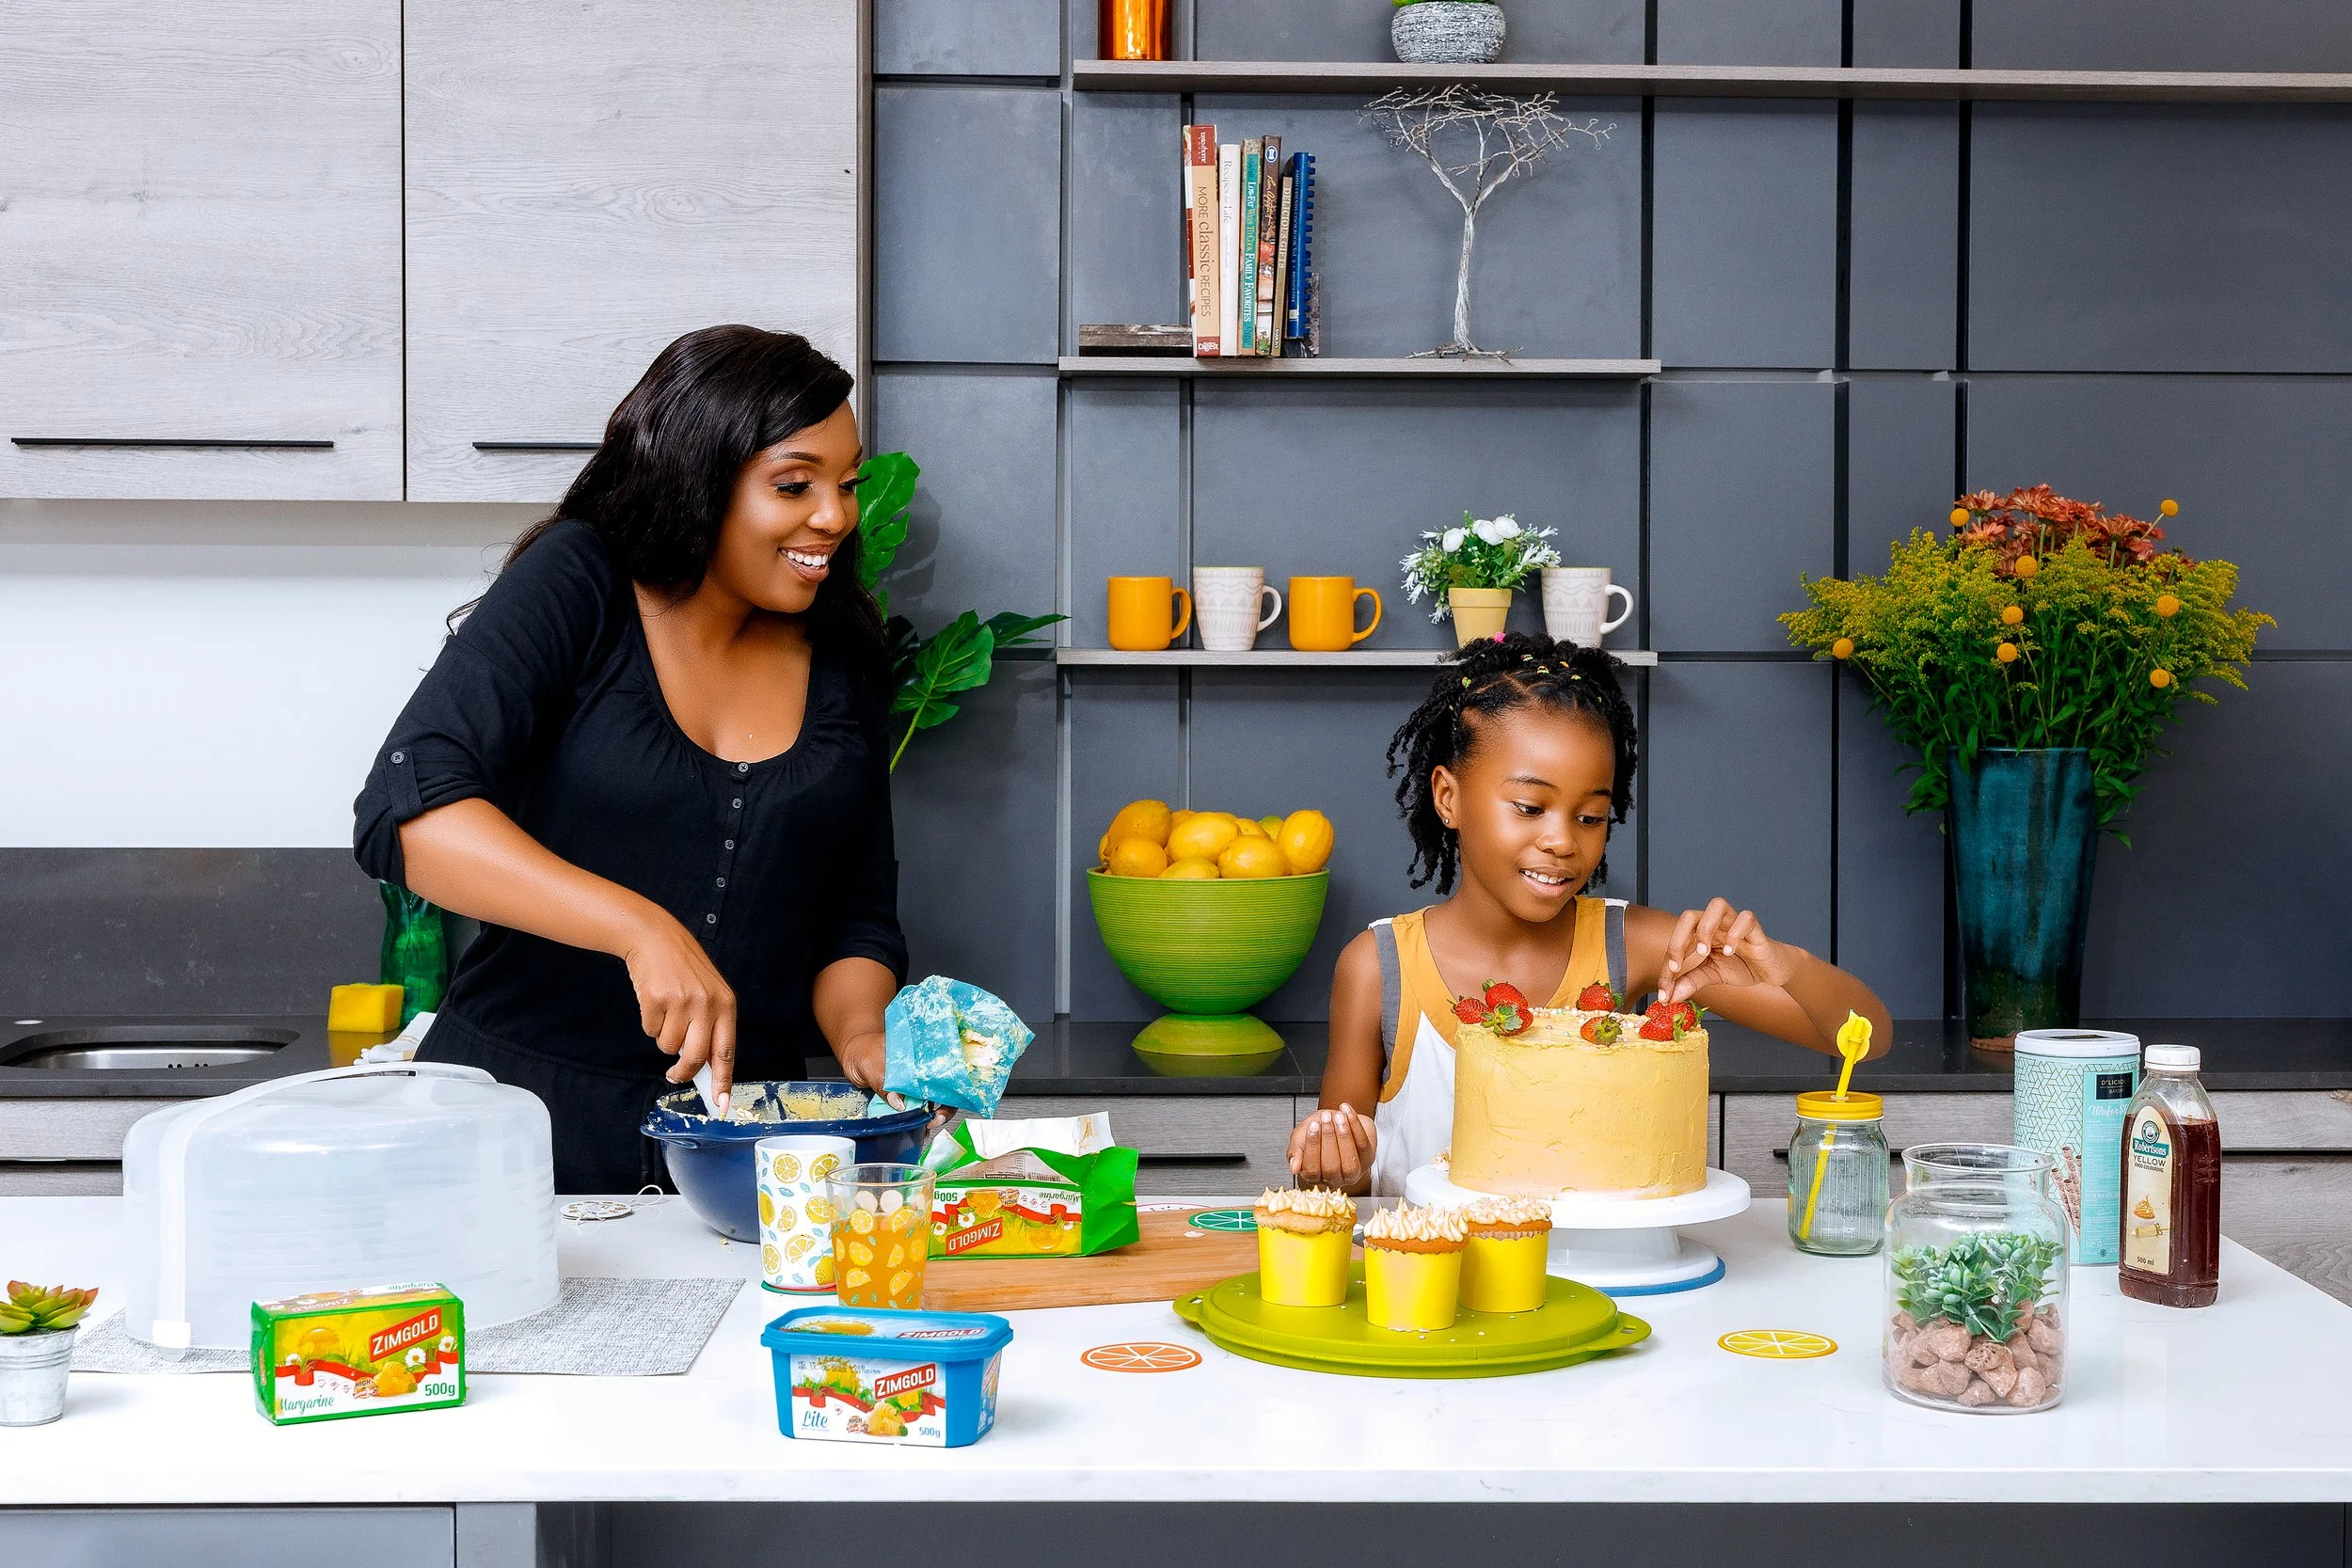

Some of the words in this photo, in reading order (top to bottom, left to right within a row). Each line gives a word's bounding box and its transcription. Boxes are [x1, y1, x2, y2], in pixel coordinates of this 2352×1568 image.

[1222, 160, 1232, 194] Recipes
[1198, 186, 1209, 218] MORE
[1280, 187, 1291, 239] DELICIOUS
[1223, 206, 1232, 224] Life
[1199, 221, 1215, 273] classic
[1279, 241, 1287, 269] GIFTS
[1245, 253, 1255, 281] FAMILY
[1200, 275, 1211, 317] RECIPES
[1244, 282, 1255, 322] FAVORITES
[2134, 1139, 2167, 1156] Robertsons
[2133, 1154, 2167, 1167] YELLOW
[1039, 1191, 1082, 1204] Margarine
[949, 1222, 1001, 1251] ZIMGOLD
[2137, 1256, 2147, 1264] 500
[292, 1298, 352, 1312] ZIMGOLD
[373, 1313, 438, 1355] ZIMGOLD
[899, 1329, 981, 1338] ZIMGOLD
[355, 1379, 371, 1387] HIGH
[424, 1382, 456, 1397] 500g
[876, 1368, 934, 1397] ZIMGOLD
[802, 1410, 829, 1428] Lite
[918, 1426, 941, 1438] 500g
